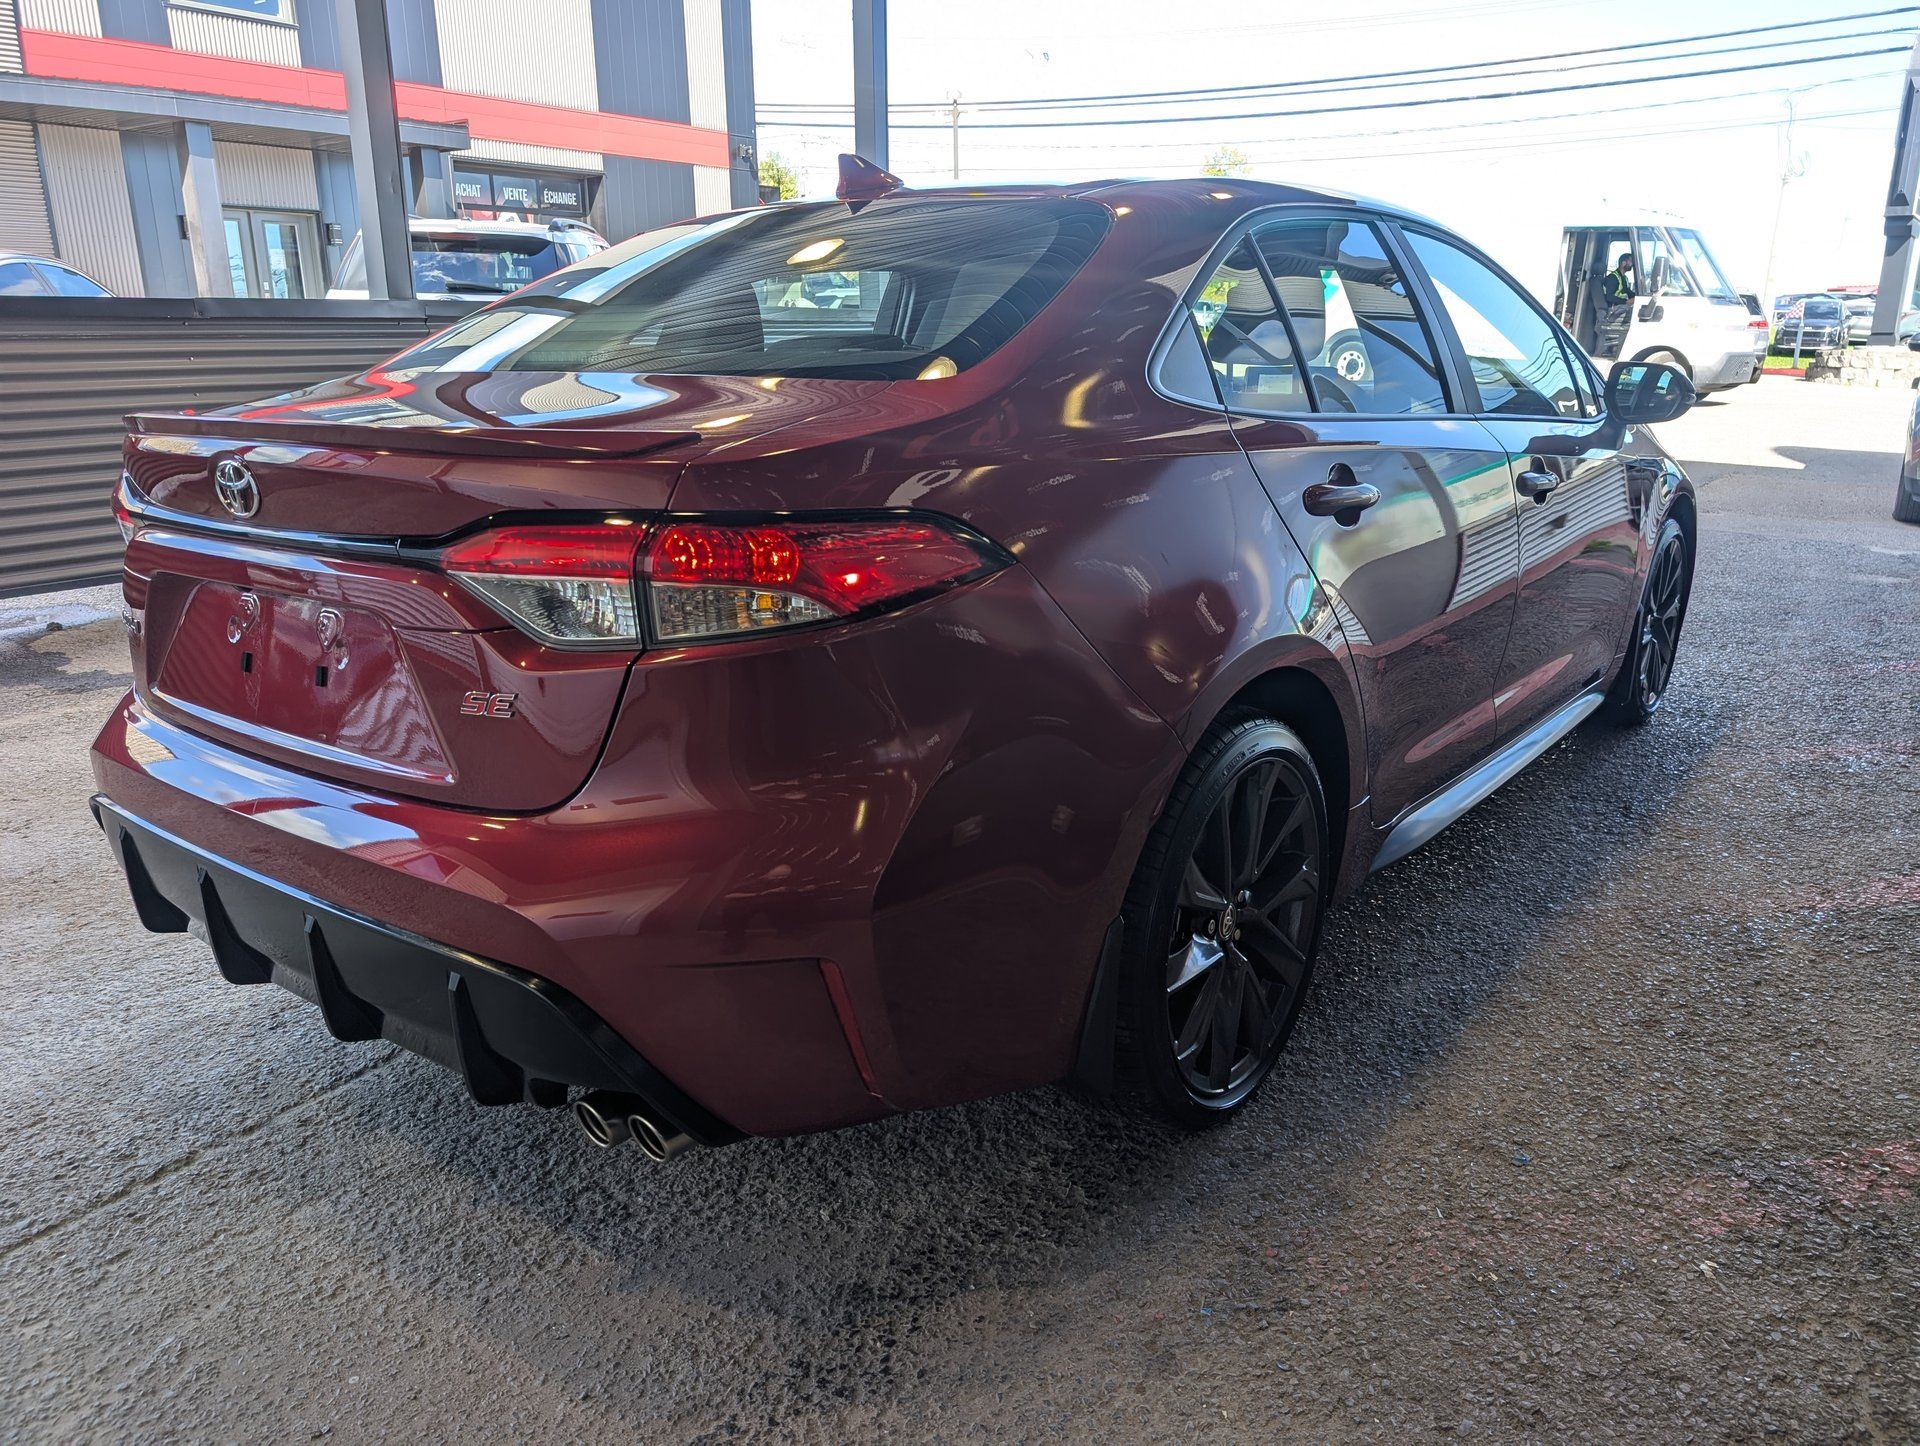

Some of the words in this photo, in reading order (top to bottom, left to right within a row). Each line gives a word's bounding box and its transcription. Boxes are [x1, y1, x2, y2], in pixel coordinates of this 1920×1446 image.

[456, 183, 481, 198] ACHAT
[503, 187, 529, 202] VENTE
[543, 188, 578, 205] ÉCHANGE
[460, 691, 516, 718] SE
